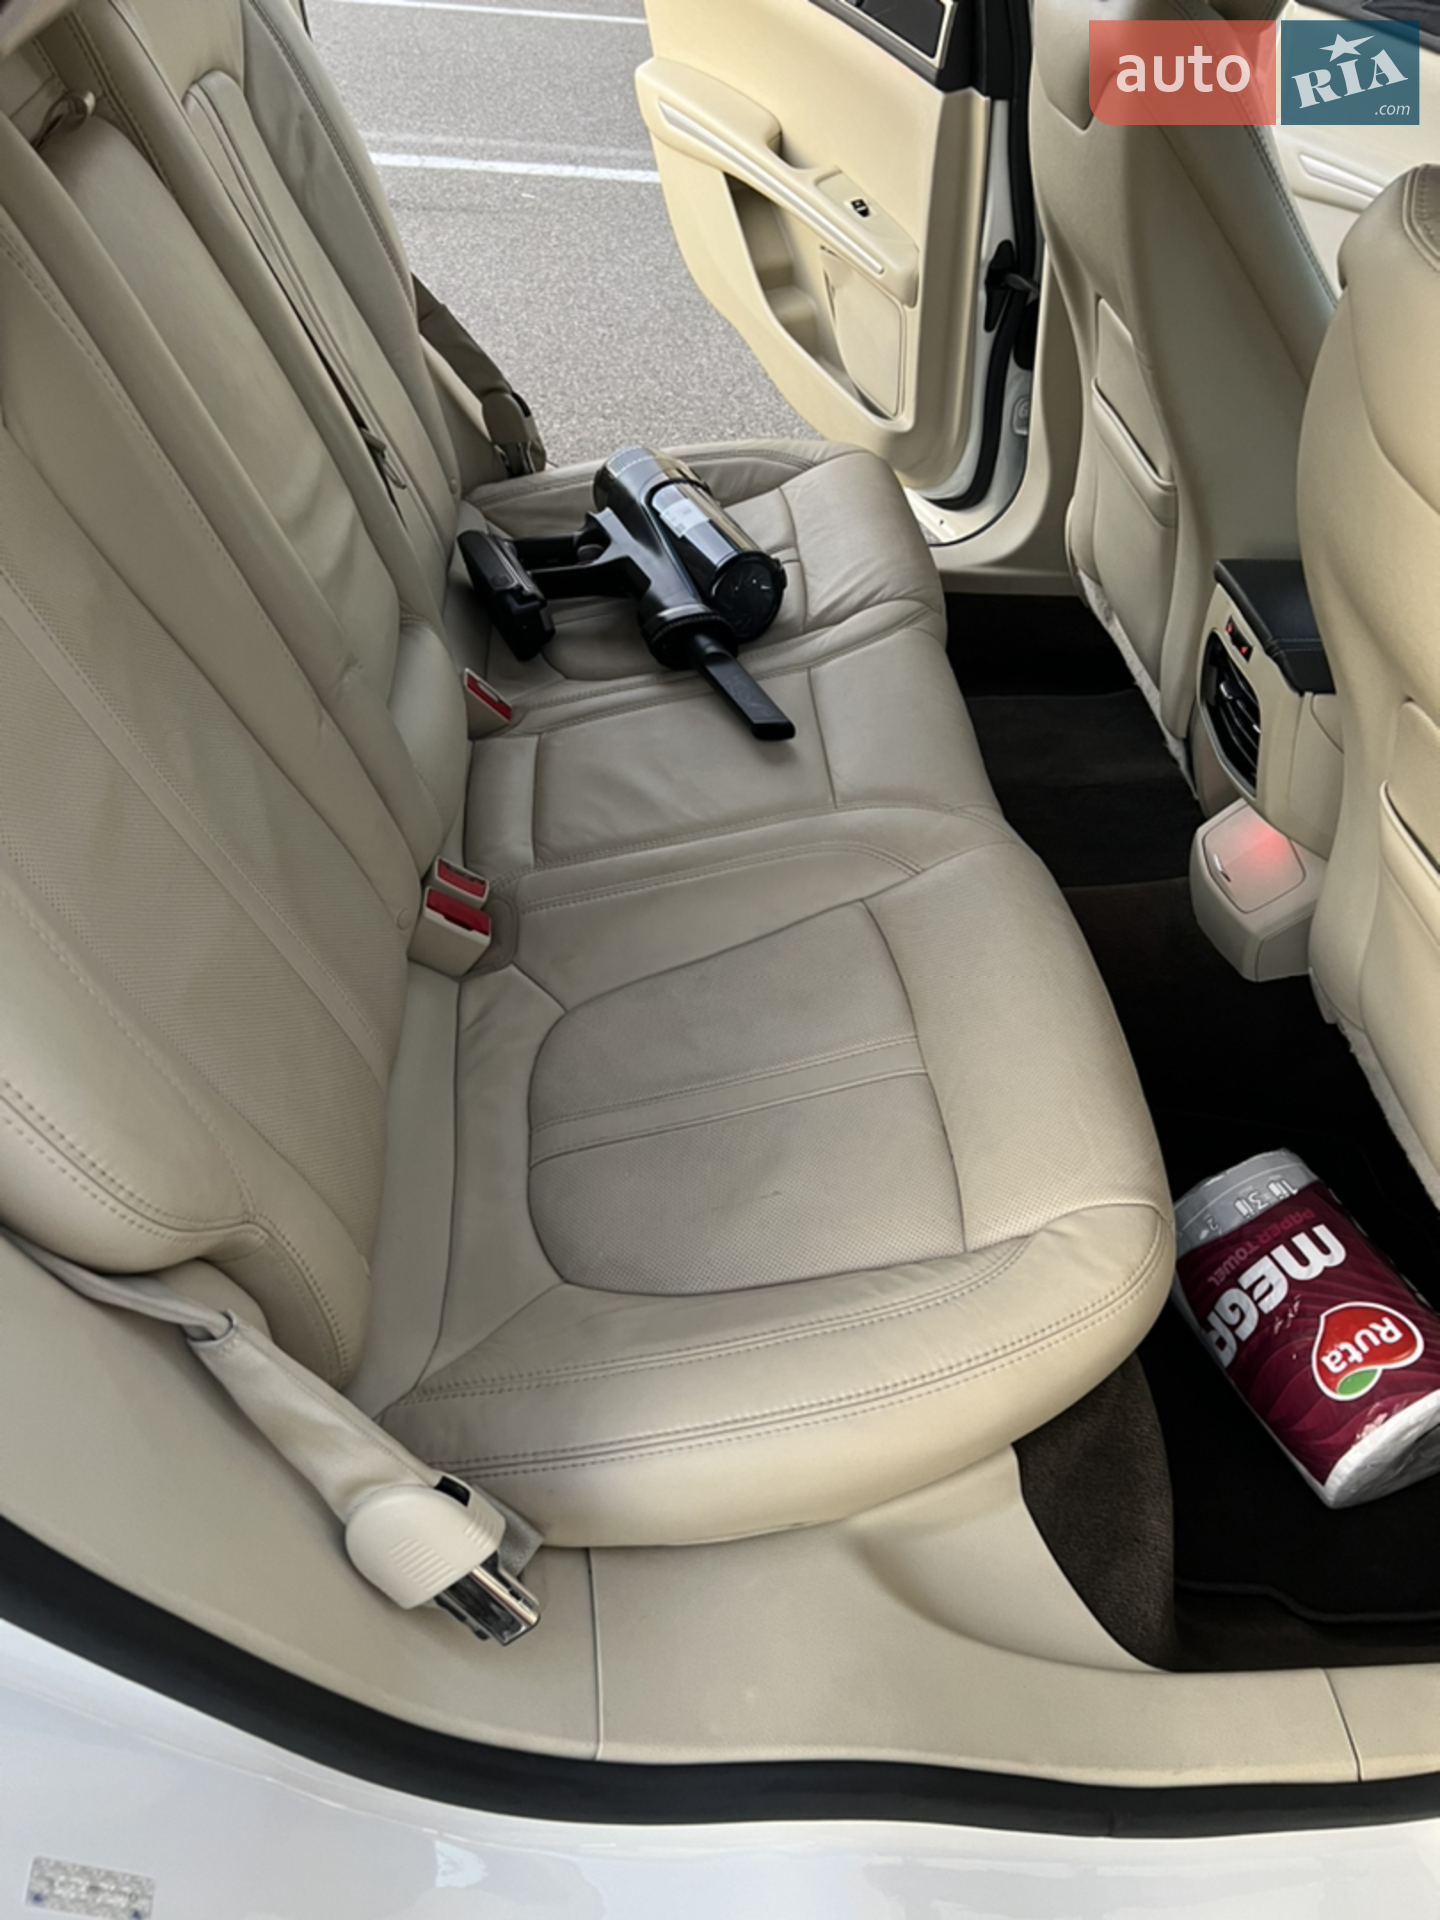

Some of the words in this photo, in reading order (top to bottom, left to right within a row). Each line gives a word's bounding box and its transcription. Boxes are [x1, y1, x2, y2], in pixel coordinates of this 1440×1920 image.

[1259, 1207, 1316, 1246] PAPER
[1207, 1234, 1263, 1287] TOWEL
[1321, 1316, 1403, 1374] Ruta
